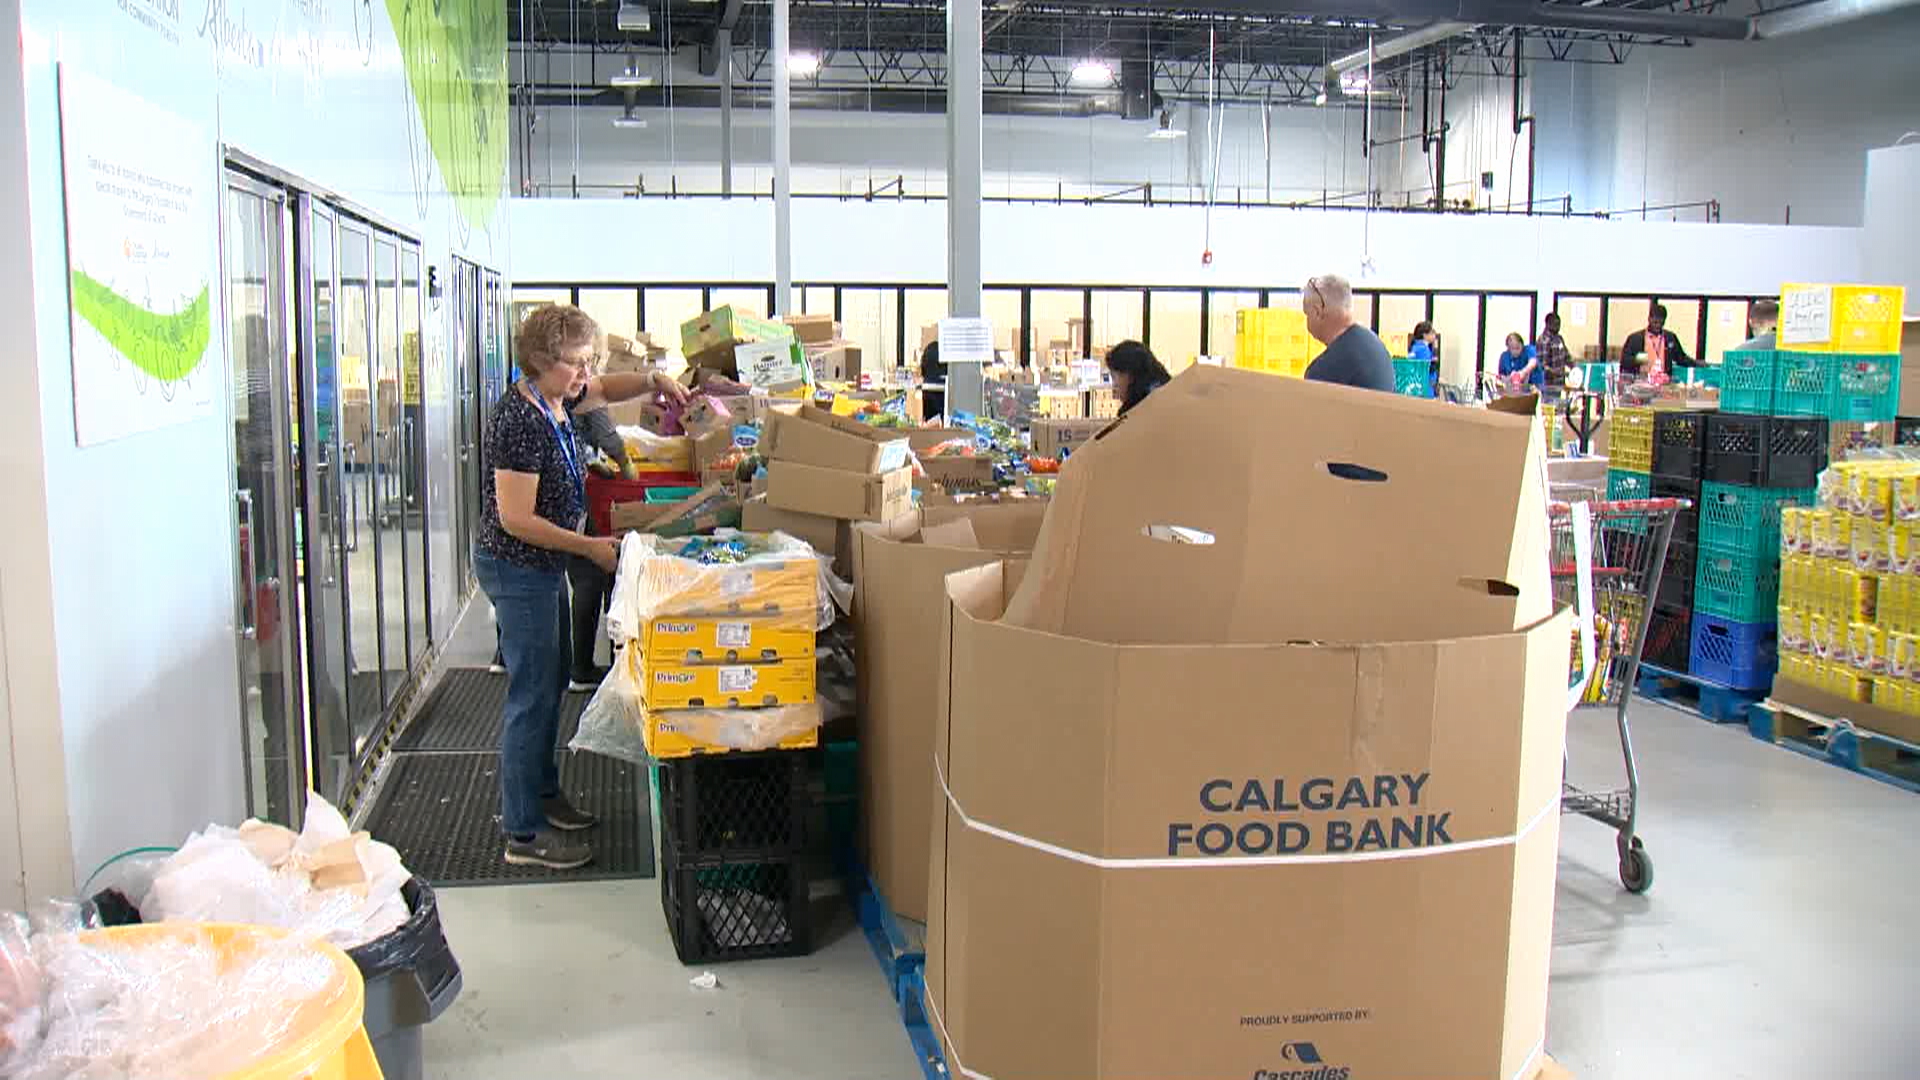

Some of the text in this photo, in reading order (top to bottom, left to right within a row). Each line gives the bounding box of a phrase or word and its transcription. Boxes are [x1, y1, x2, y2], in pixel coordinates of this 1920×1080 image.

[1199, 772, 1431, 814] CALGARY
[1168, 811, 1453, 857] FOOD BANK
[1240, 1015, 1290, 1026] PROUDLY
[1292, 1011, 1353, 1025] SUPPORTED
[1253, 1066, 1351, 1080] Cascades
